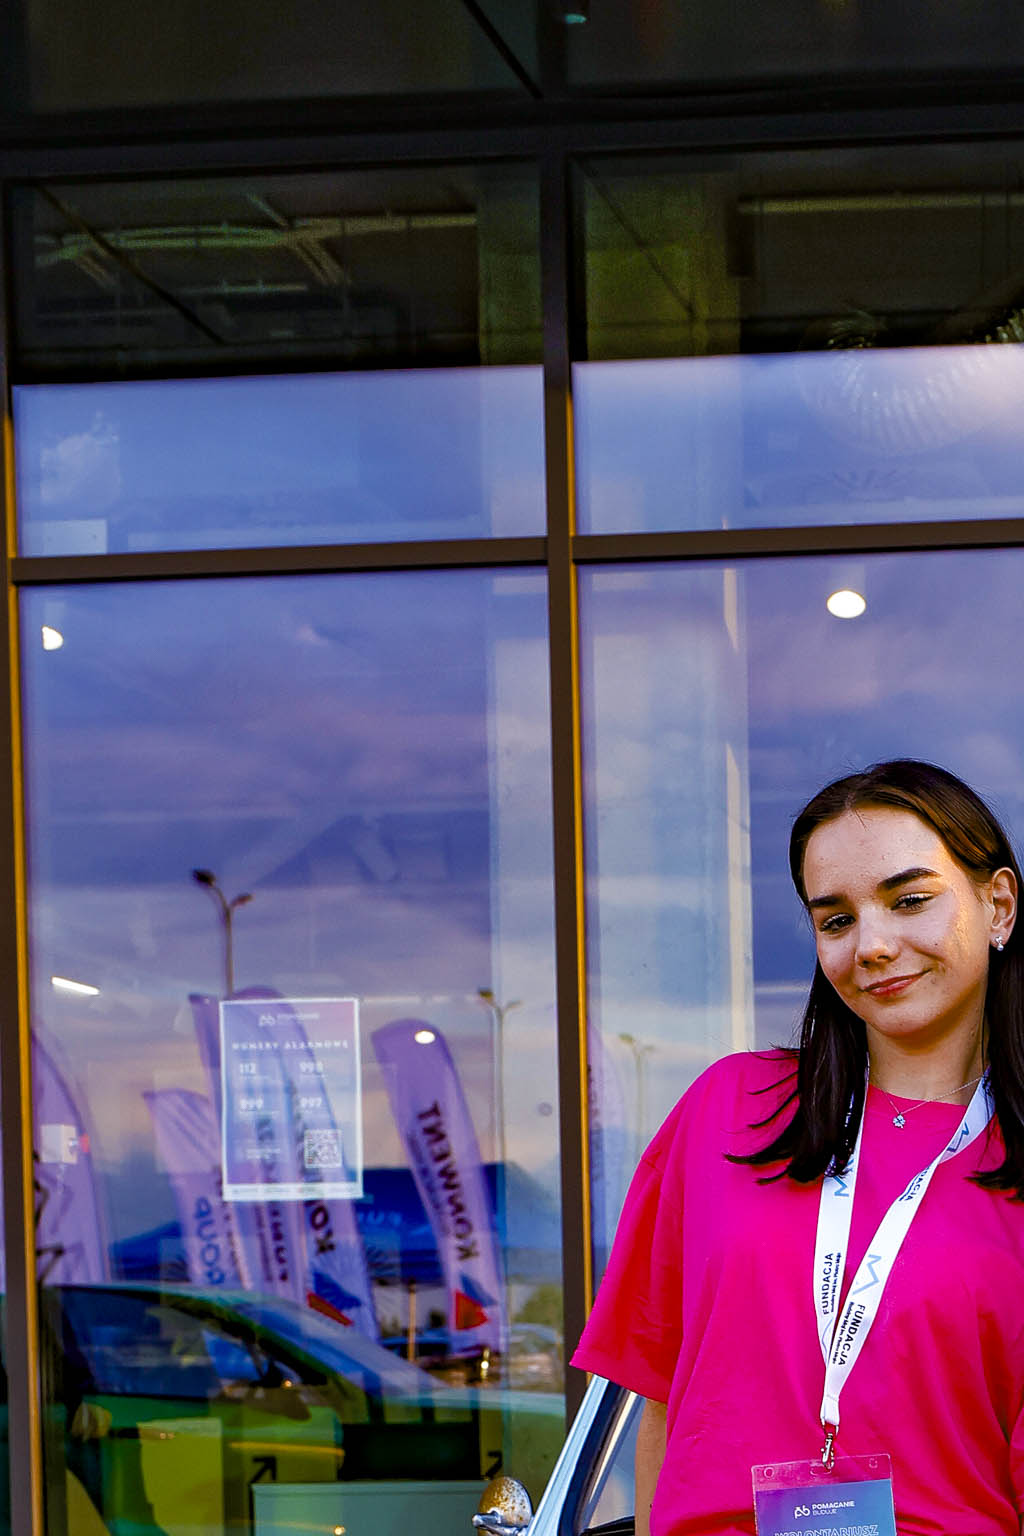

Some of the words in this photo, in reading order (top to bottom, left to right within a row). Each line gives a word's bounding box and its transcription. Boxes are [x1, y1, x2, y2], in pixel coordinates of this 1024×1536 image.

[821, 1252, 834, 1315] FUNDACJA
[837, 1303, 866, 1366] FUNDACJA
[811, 1500, 856, 1510] POMAGANIE
